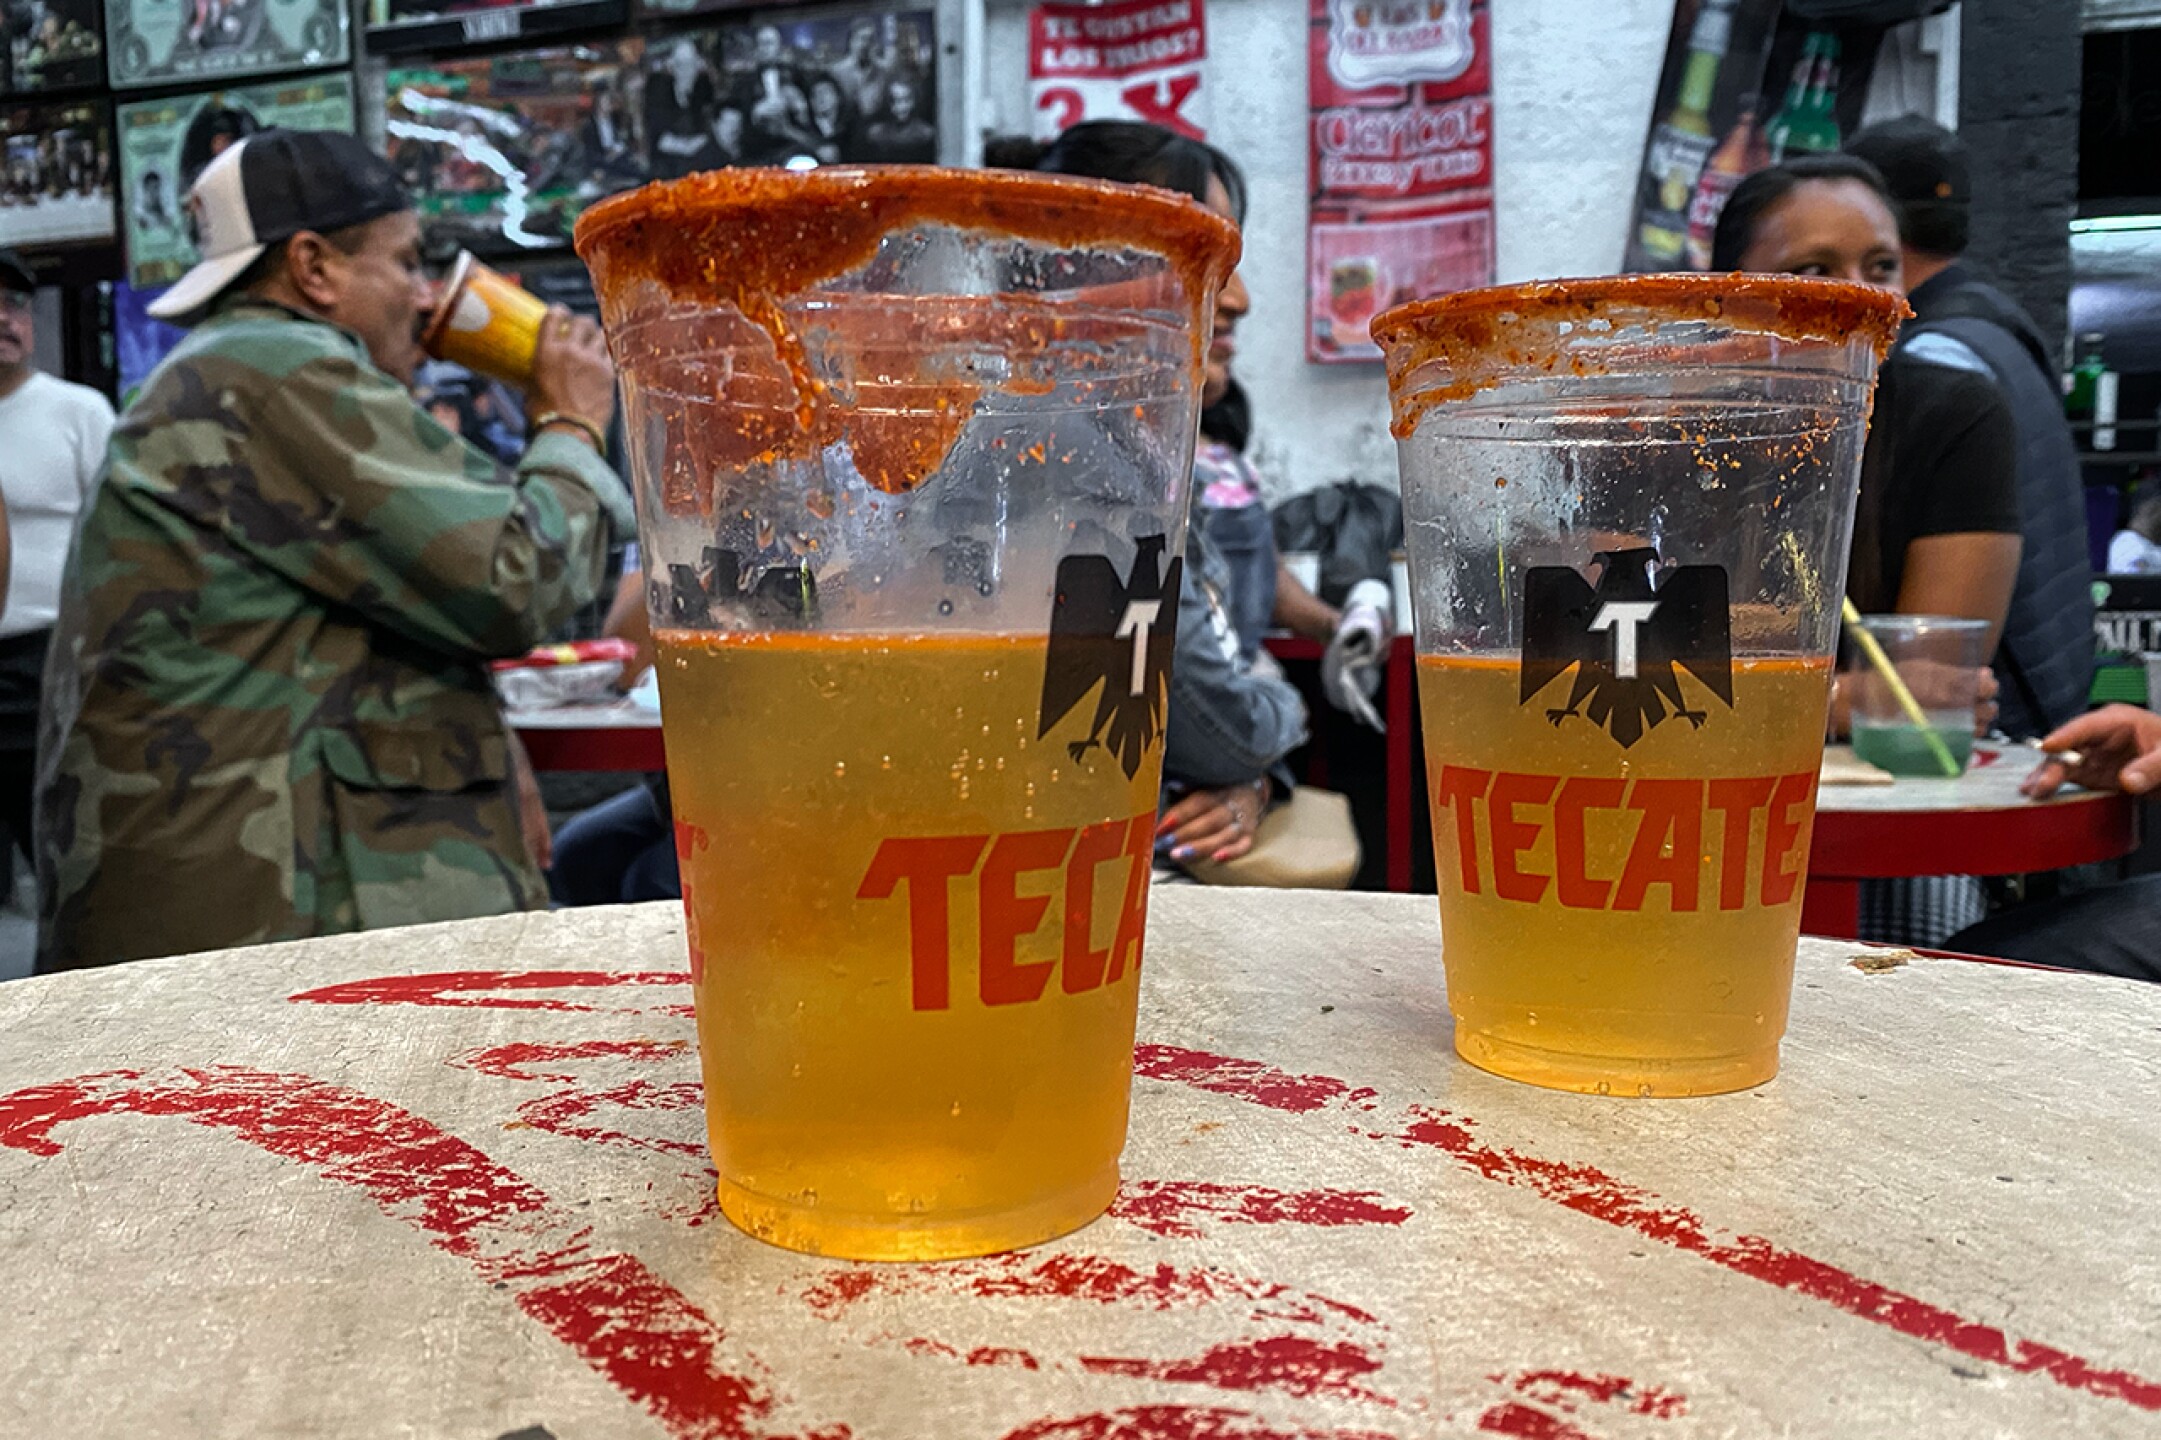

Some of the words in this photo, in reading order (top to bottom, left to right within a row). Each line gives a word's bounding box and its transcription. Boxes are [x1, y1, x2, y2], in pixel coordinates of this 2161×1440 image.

[1041, 45, 1100, 69] LOS
[1115, 598, 1162, 697] T
[1588, 600, 1662, 679] T
[1439, 763, 1815, 912] TECATE
